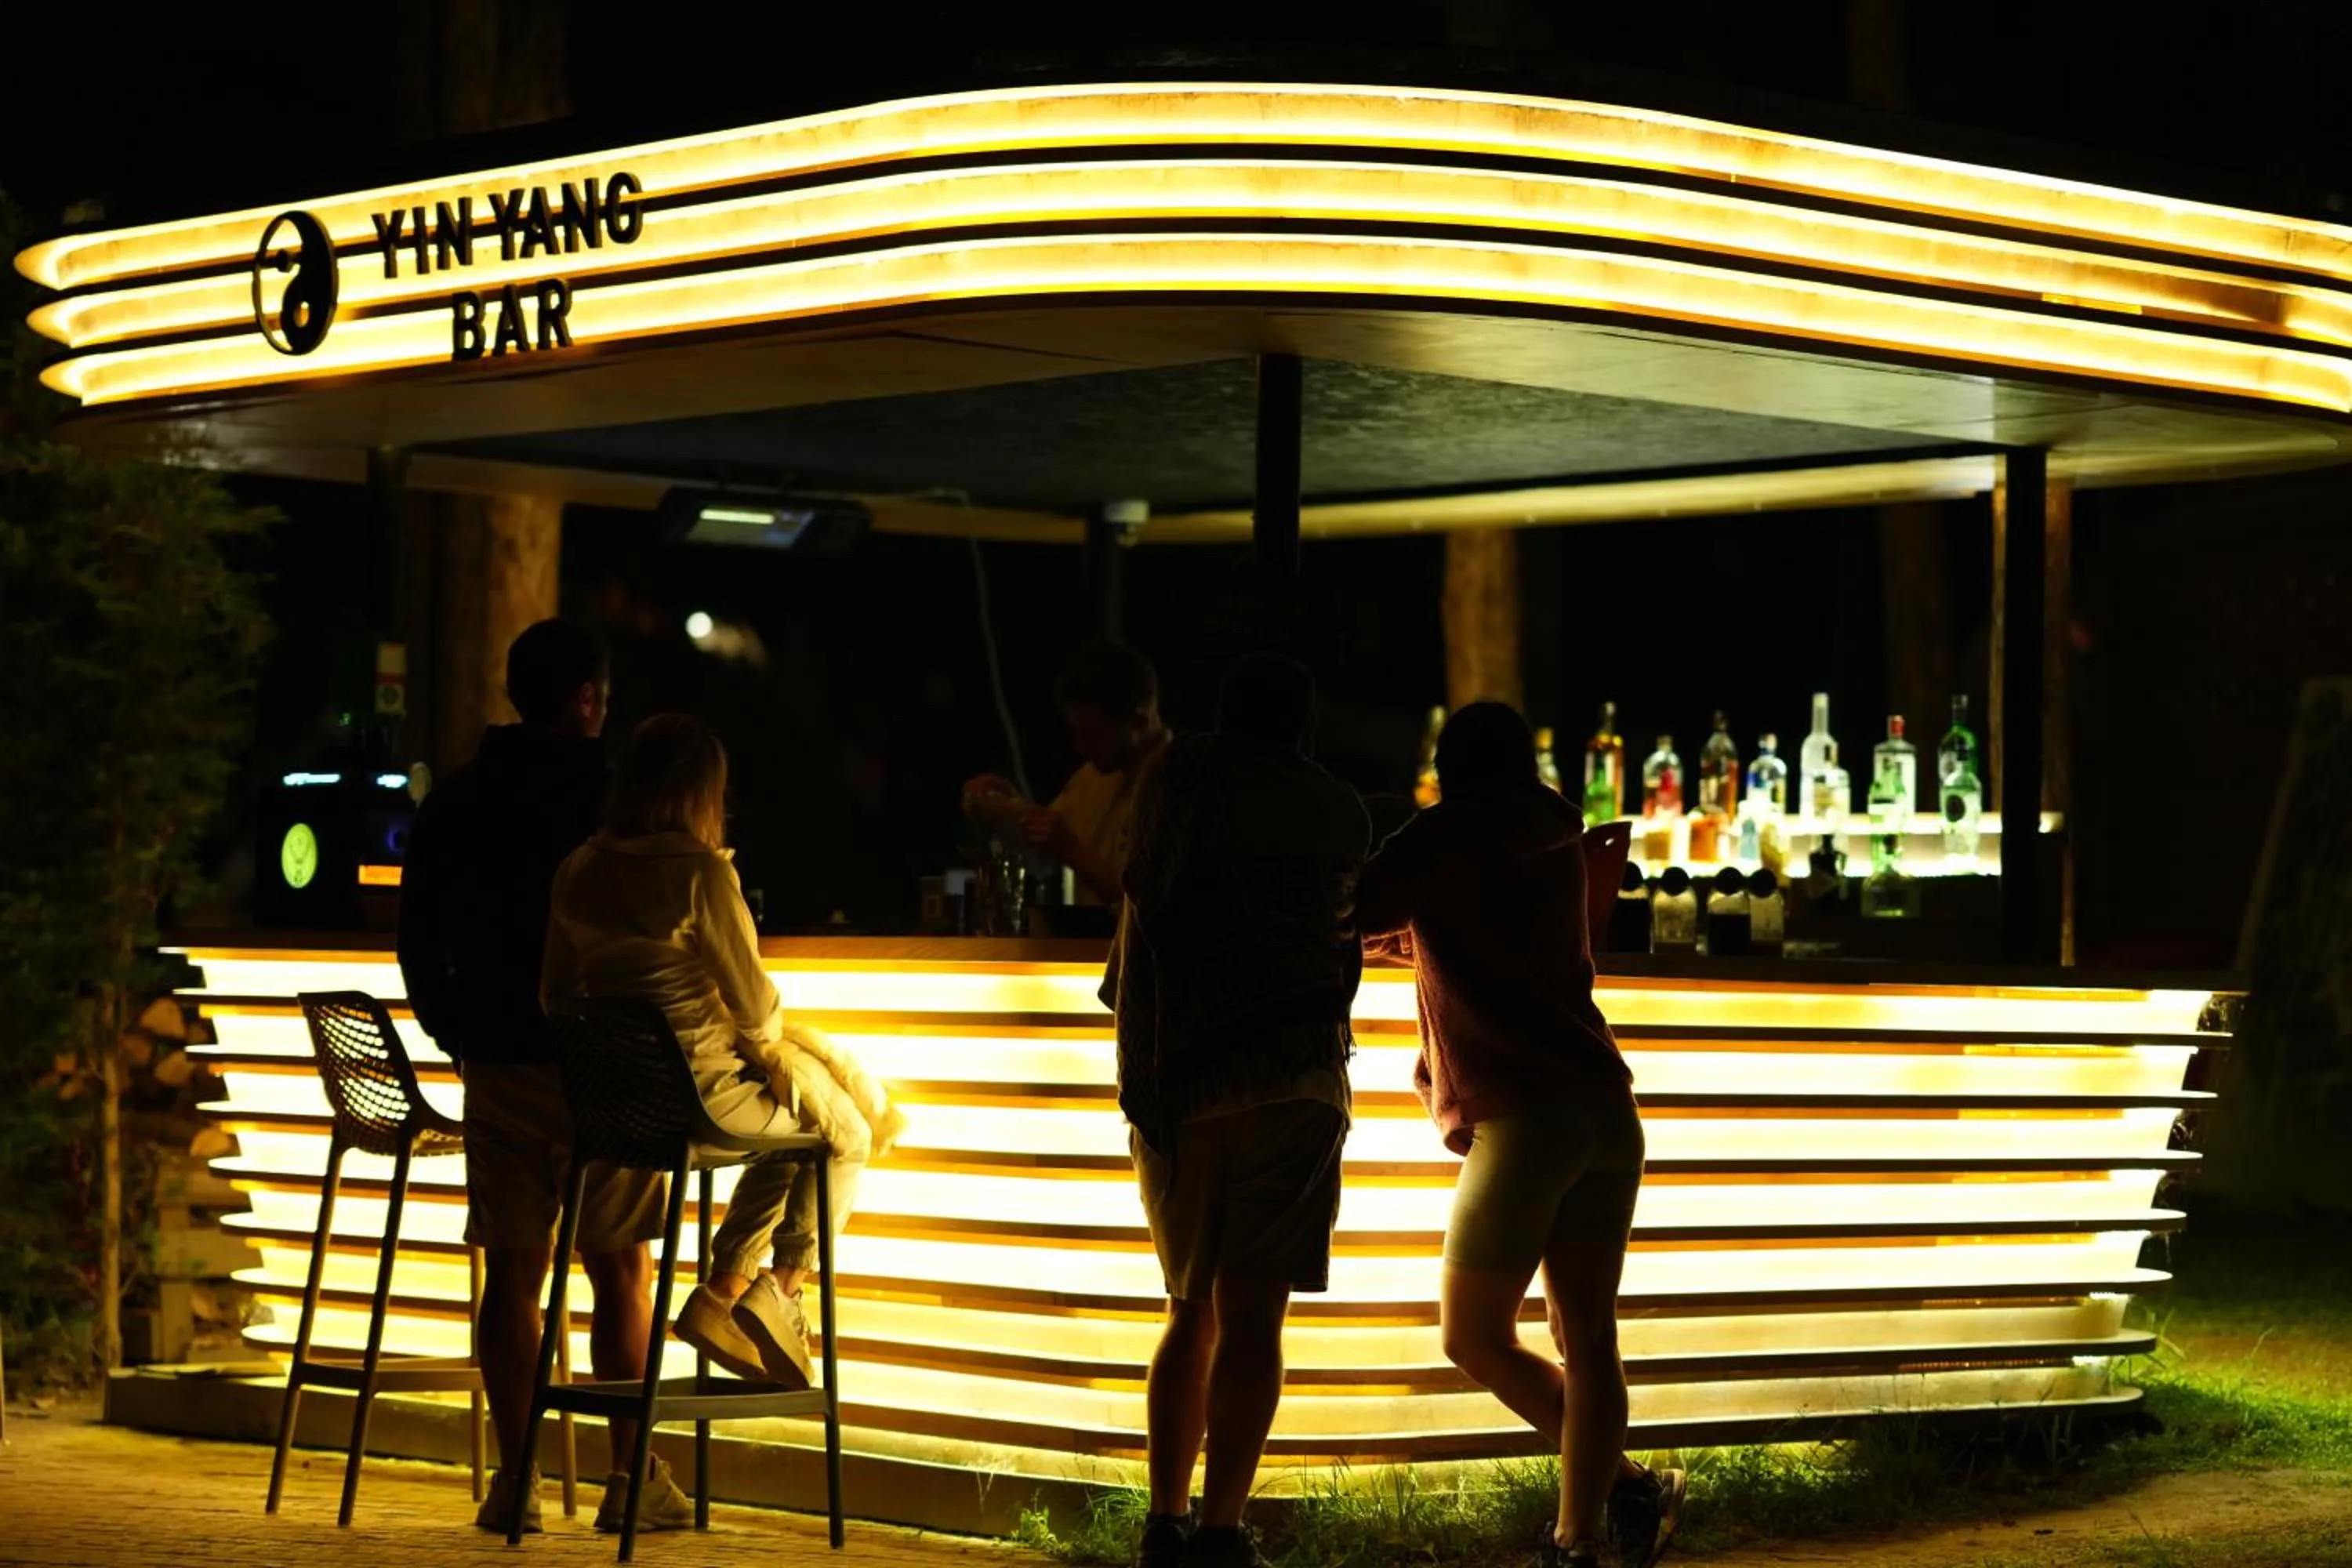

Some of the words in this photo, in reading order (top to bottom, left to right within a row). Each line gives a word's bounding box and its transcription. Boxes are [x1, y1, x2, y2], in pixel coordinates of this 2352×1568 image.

[372, 197, 473, 278] YIN
[488, 172, 644, 260] YANG
[452, 279, 573, 361] BAR
